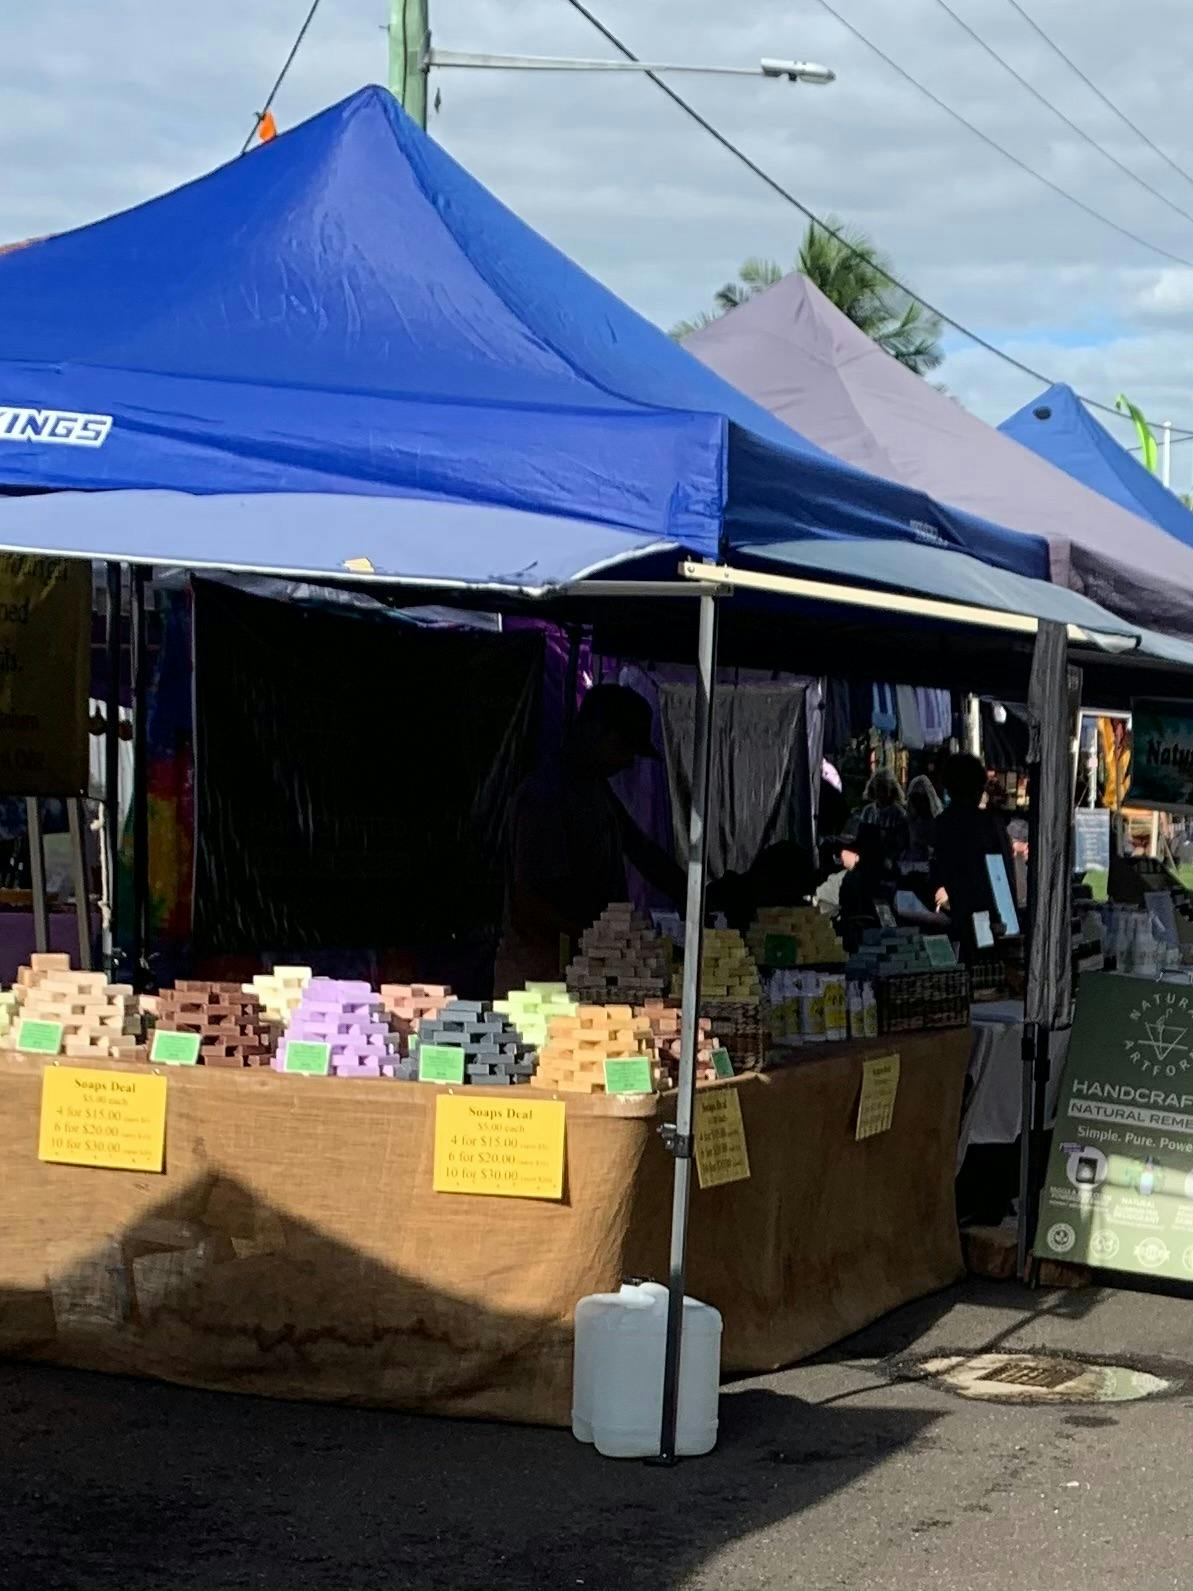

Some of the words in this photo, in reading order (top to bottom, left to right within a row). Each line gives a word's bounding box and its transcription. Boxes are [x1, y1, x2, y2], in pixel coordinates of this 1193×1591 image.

[0, 408, 110, 445] INGS
[74, 1079, 107, 1092] Soaps
[111, 1081, 136, 1093] Deal
[56, 1105, 63, 1115] 4
[67, 1106, 82, 1117] for
[468, 1105, 502, 1120] Soaps
[507, 1108, 533, 1120] Deal
[1070, 1102, 1147, 1123] NATURAL
[450, 1134, 457, 1145] 4
[461, 1135, 476, 1146] for
[480, 1136, 518, 1149] $15.00
[1077, 1125, 1122, 1143] Simple.
[1125, 1132, 1156, 1148] Pure.
[448, 1152, 455, 1162] 6
[459, 1151, 474, 1163] for
[478, 1152, 516, 1165] $20.00
[445, 1166, 458, 1178] 10
[462, 1166, 476, 1179] for
